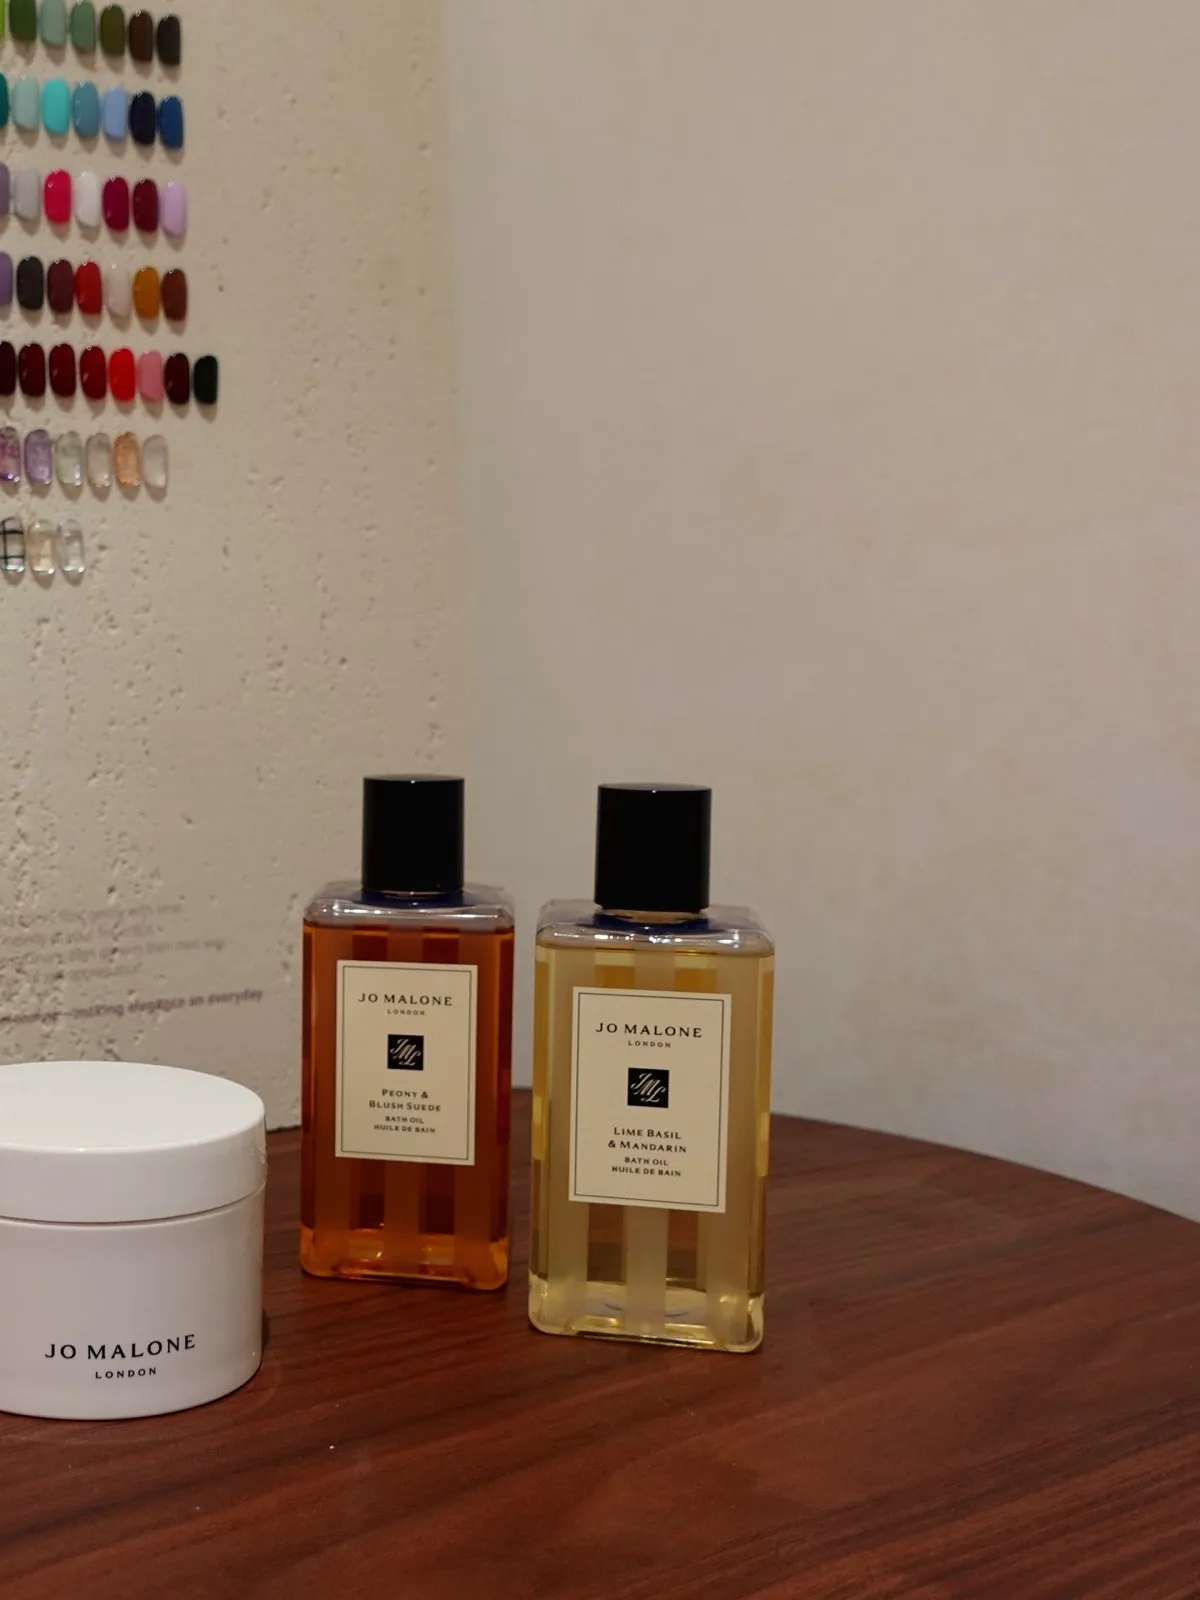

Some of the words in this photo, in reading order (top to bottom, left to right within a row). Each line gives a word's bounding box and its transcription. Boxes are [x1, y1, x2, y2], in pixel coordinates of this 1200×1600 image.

[208, 989, 263, 1005] everyday
[359, 993, 378, 1003] JO
[384, 994, 453, 1006] MALONE
[596, 1023, 617, 1033] JO
[625, 1024, 702, 1038] MALONE
[625, 1157, 649, 1165] BATH
[612, 1166, 640, 1174] HUILE
[658, 1169, 681, 1177] BAIN
[45, 1344, 76, 1359] JO
[88, 1334, 195, 1359] MALONE
[96, 1367, 157, 1379] LONDON
